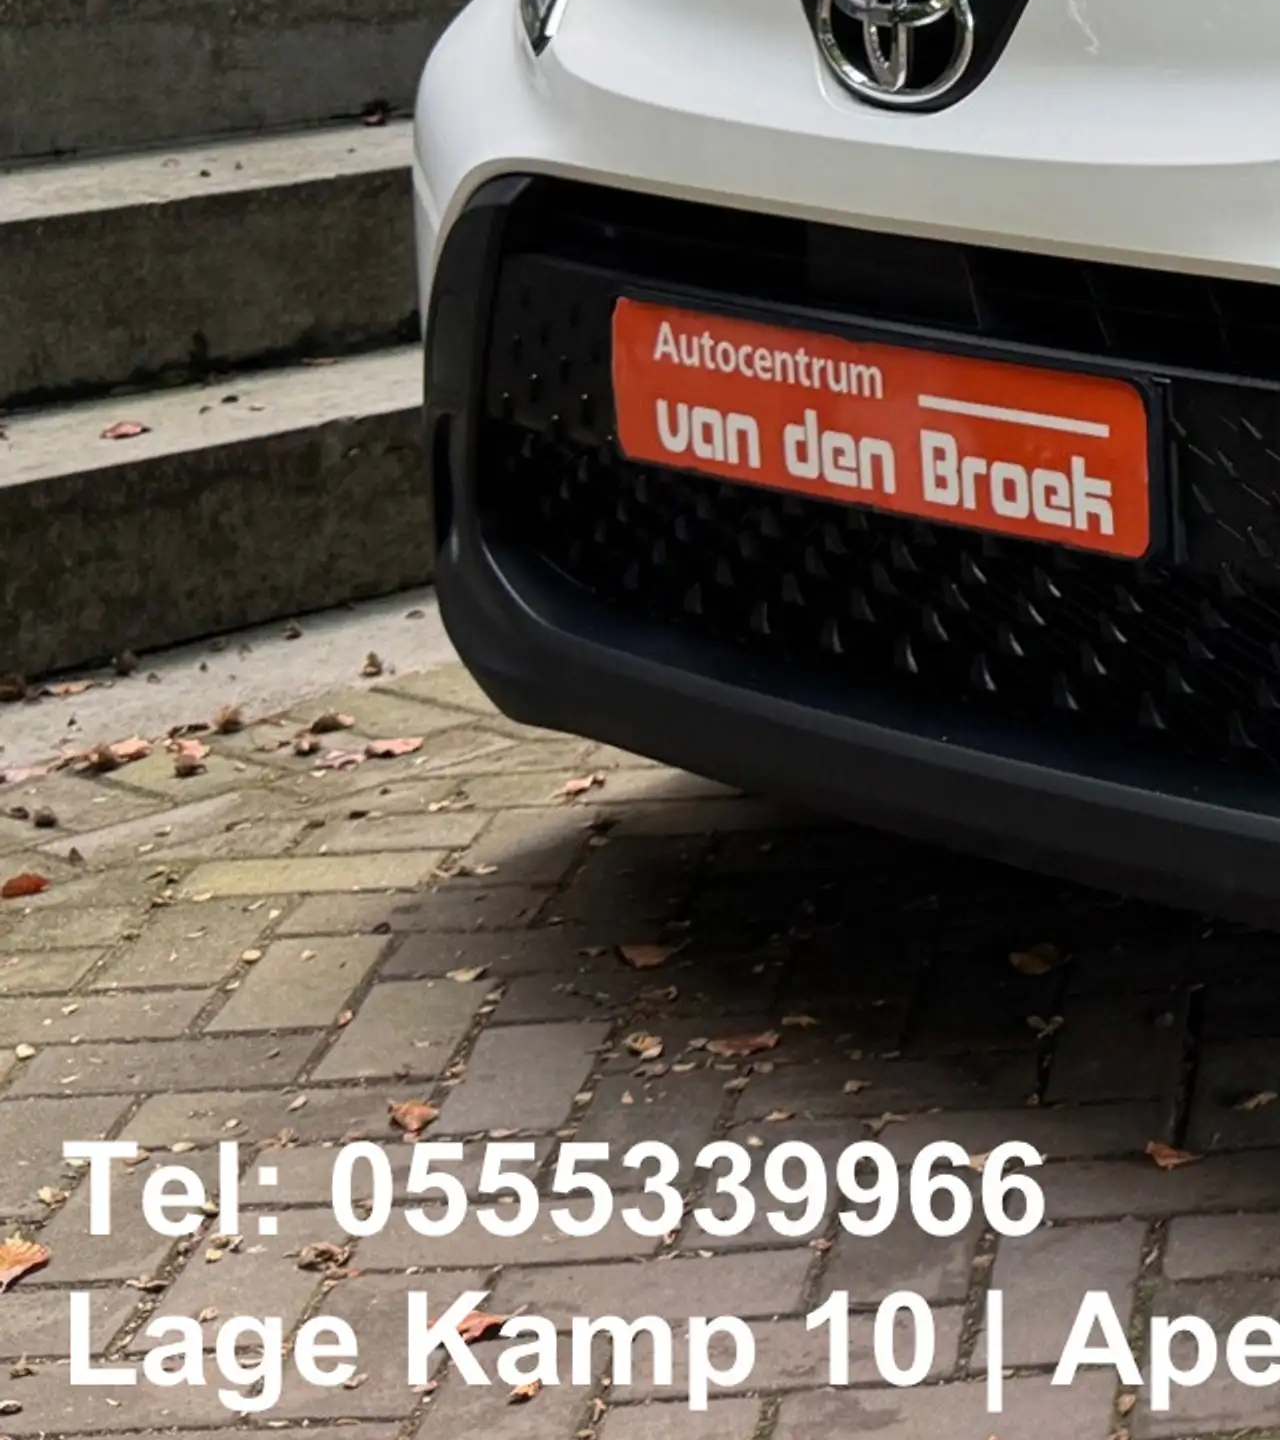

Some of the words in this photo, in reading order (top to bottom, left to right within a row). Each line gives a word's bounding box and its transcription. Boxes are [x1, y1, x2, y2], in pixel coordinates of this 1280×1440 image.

[652, 320, 884, 401] Autocentrum
[655, 397, 761, 470] van
[782, 406, 898, 496] den
[918, 428, 1115, 537] Broek
